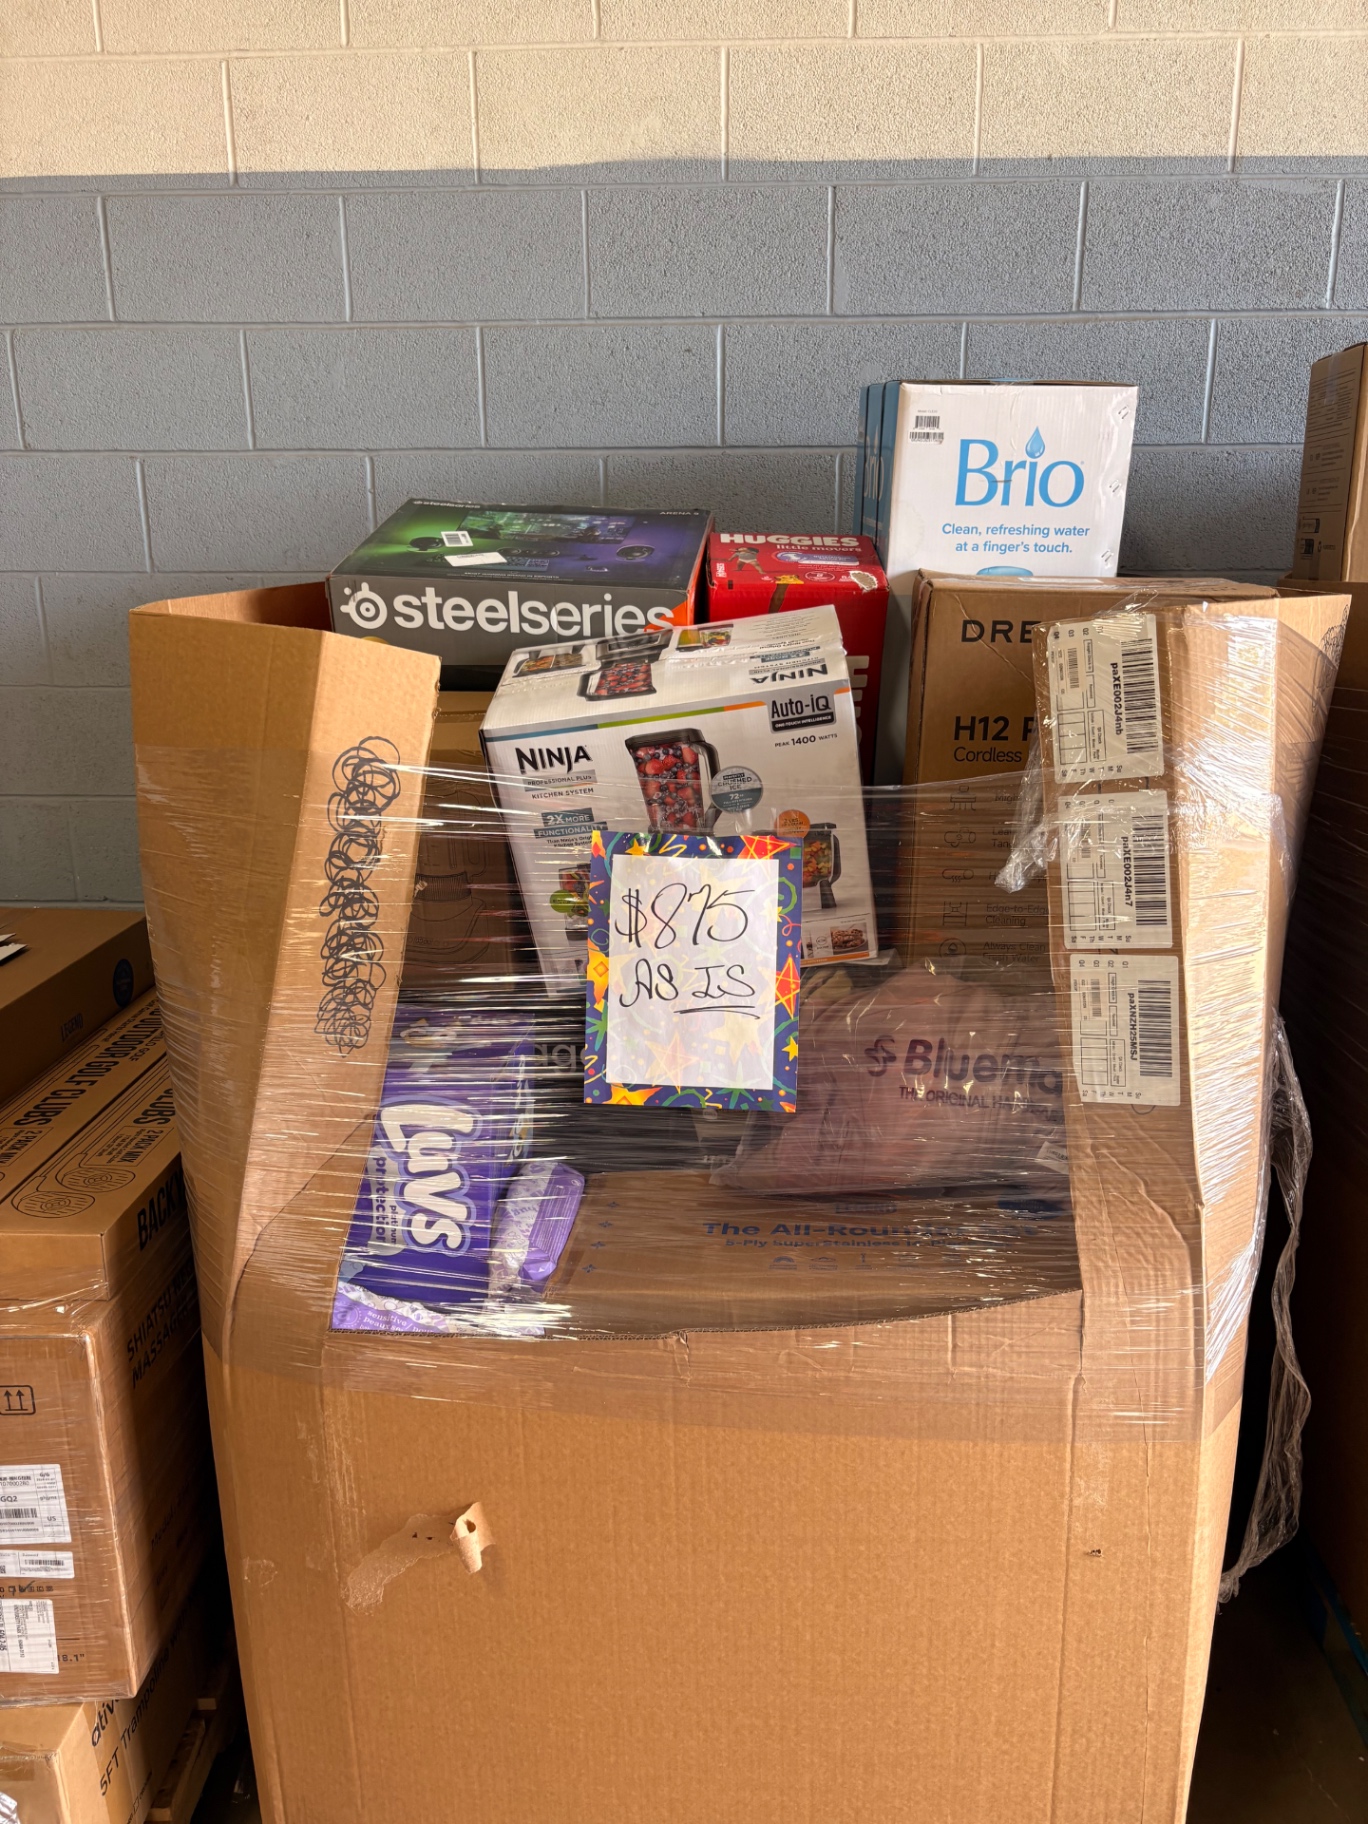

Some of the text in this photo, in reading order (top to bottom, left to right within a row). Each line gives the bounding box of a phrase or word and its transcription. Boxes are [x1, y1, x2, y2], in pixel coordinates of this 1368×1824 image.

[954, 438, 1085, 508] Brio
[942, 523, 1090, 538] Clean, refreshing water
[720, 534, 860, 547] HUGGIES
[955, 541, 1073, 555] at a finger's touch.
[393, 586, 675, 637] steelseries
[1082, 627, 1090, 636] Q2
[749, 664, 829, 684] NINJA
[1110, 661, 1124, 736] paXE002J4nb
[770, 694, 832, 720] Auto-iQ
[954, 715, 1010, 742] H12
[790, 734, 817, 746] 1400
[818, 733, 838, 741] WATTS
[515, 745, 594, 774] NINJA
[954, 746, 1022, 763] Cordless
[527, 774, 592, 786] PROFESSIONAL PLUS
[531, 787, 594, 800] KITCHEN SYSTEM
[546, 814, 591, 825] 2X MORE
[614, 882, 756, 950] $875
[983, 940, 1046, 952] Always Clean
[1079, 959, 1086, 968] Q4
[1093, 960, 1100, 968] Q3
[1107, 960, 1115, 968] Q2
[1122, 960, 1129, 968] Q1
[618, 958, 756, 1008] AS IS
[129, 1047, 151, 1062] GOLF
[13, 1017, 162, 1126] OUTDOOR GOLF CLUBS
[925, 1089, 990, 1109] ORIGINAL
[12, 1135, 36, 1152] PACK
[134, 1134, 160, 1152] PACK
[117, 1151, 142, 1163] MIX
[380, 1103, 475, 1251] Luvs
[373, 1156, 389, 1245] protection
[703, 1222, 760, 1235] The
[725, 1240, 768, 1248] 5-Ply
[366, 1310, 407, 1326] sensitive
[127, 1291, 172, 1362] SHIATSU
[99, 1745, 119, 1796] 5FT
[120, 1645, 170, 1750] Trampoline
